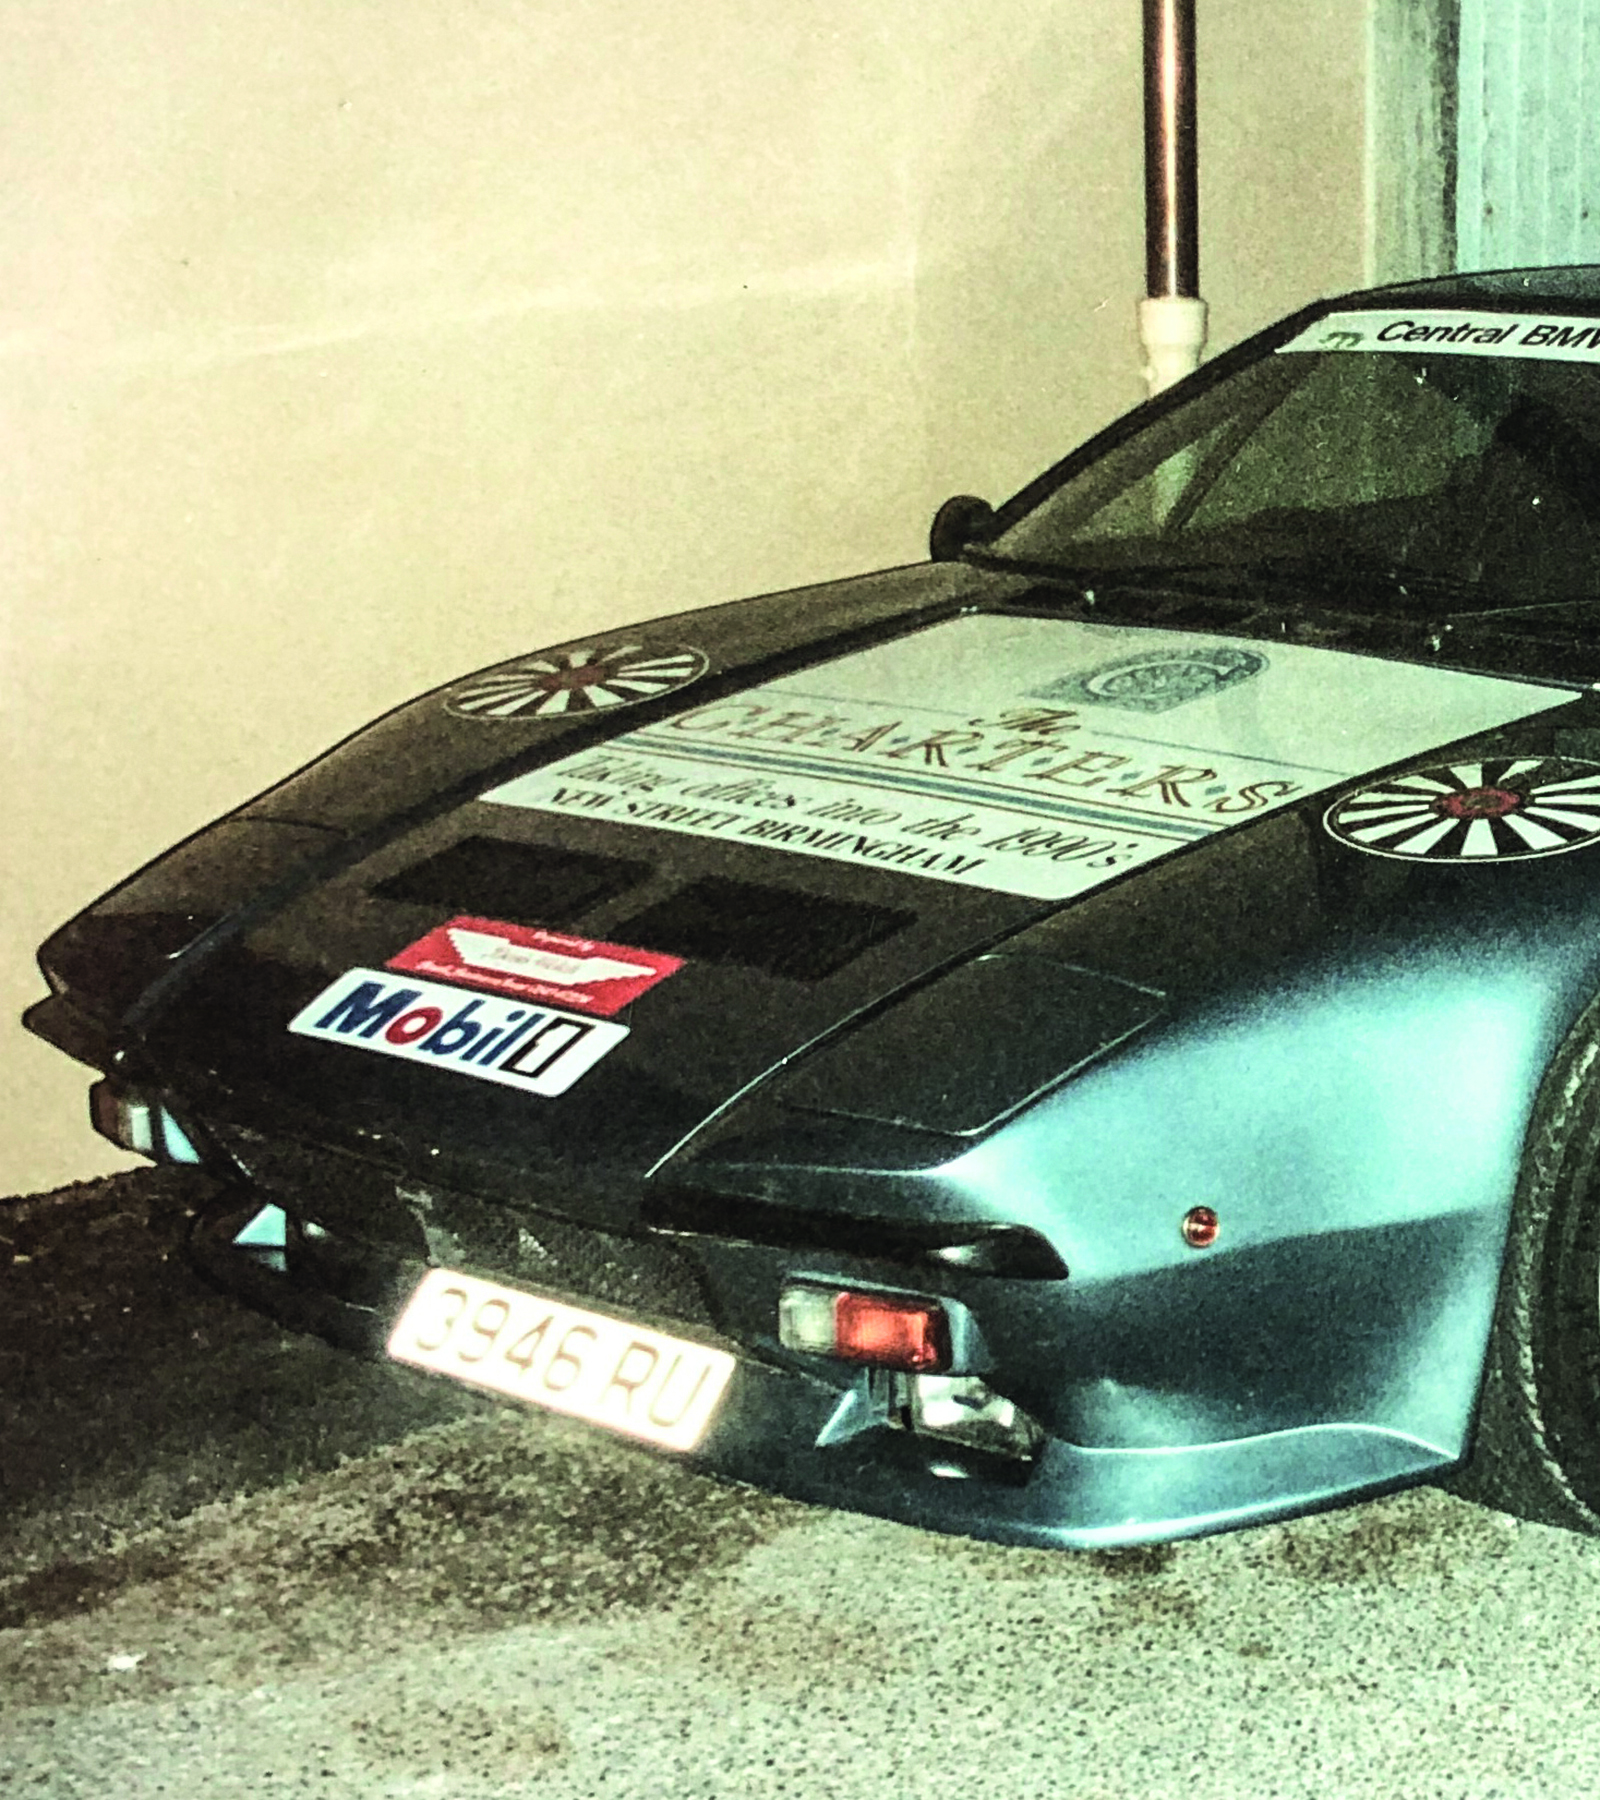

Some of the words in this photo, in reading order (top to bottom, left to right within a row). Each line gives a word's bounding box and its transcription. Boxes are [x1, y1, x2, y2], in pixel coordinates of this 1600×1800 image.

[1376, 320, 1519, 345] Central
[966, 706, 1082, 736] The
[551, 786, 616, 809] NEW
[613, 801, 748, 831] STREET
[738, 818, 987, 875] BIRMINGHAM
[806, 797, 902, 826] into
[901, 813, 982, 841] the
[980, 825, 1140, 868] 1990's
[314, 979, 546, 1067] Mobil
[497, 1015, 596, 1079] 1
[414, 1286, 599, 1393] 3946
[600, 1339, 713, 1429] RU
